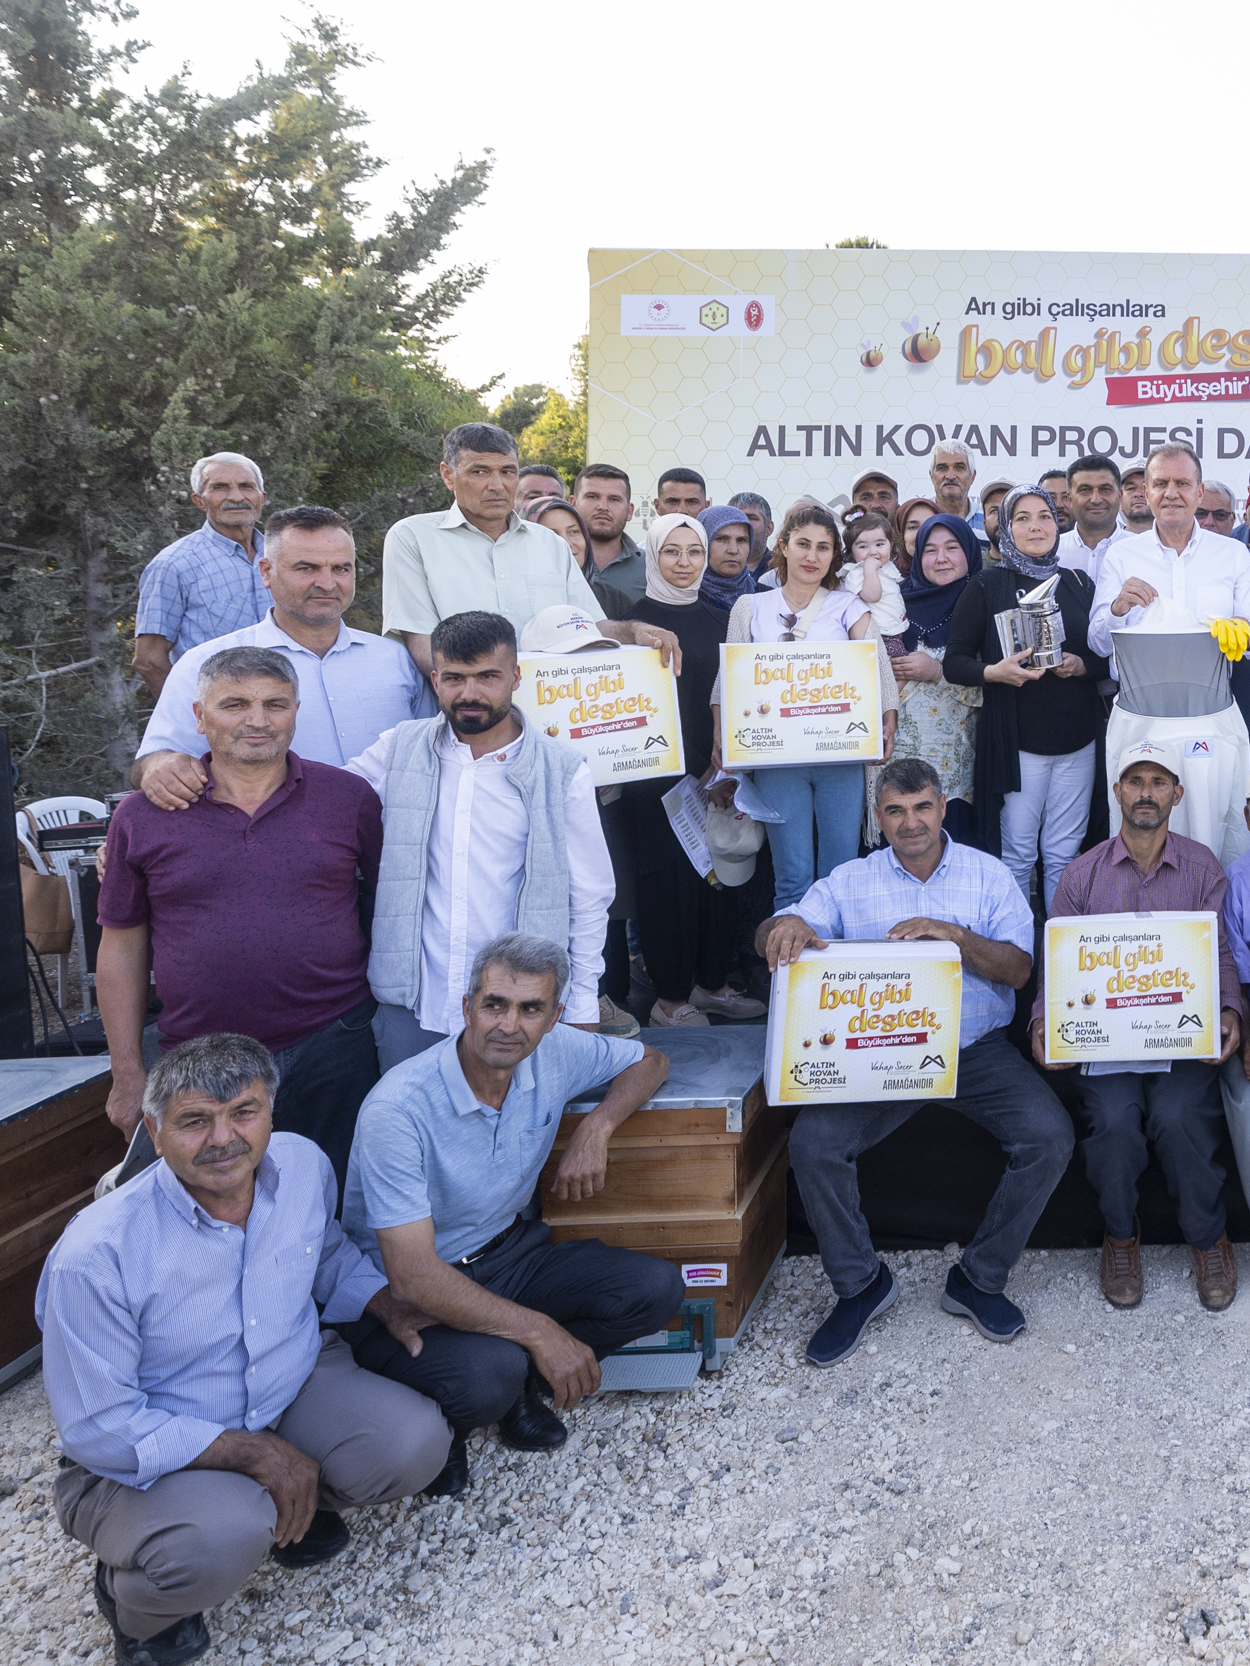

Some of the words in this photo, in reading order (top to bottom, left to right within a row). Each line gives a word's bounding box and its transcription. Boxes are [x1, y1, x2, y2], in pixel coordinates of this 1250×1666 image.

[964, 296, 996, 316] Arı
[1002, 298, 1041, 320] gibi
[1049, 299, 1166, 321] çalışanlara
[961, 323, 1057, 381] bal
[1065, 326, 1152, 387] gibi
[746, 424, 863, 457] ALTIN
[1031, 419, 1202, 459] PROJESİ
[768, 653, 784, 662] gibi
[786, 652, 831, 661] çalışanlara
[551, 667, 569, 678] gibi
[571, 663, 621, 676] çalışanlara
[754, 662, 794, 685] bal
[797, 661, 833, 686] gibi
[536, 676, 581, 707] bal
[585, 672, 625, 701] gibi
[751, 739, 784, 747] PROJESİ
[1093, 934, 1110, 945] gibi
[1112, 933, 1161, 943] çalışanlara
[1078, 945, 1121, 972] bal
[1124, 943, 1163, 972] gibi
[838, 971, 857, 981] gibi
[859, 971, 911, 982] çalışanlara
[819, 983, 867, 1010] bal
[870, 982, 912, 1011] gibi
[1075, 1028, 1102, 1036] KOVAN
[1075, 1035, 1110, 1043] PROJESİ
[810, 1061, 835, 1069] ALTIN
[809, 1075, 846, 1085] PROJESİ
